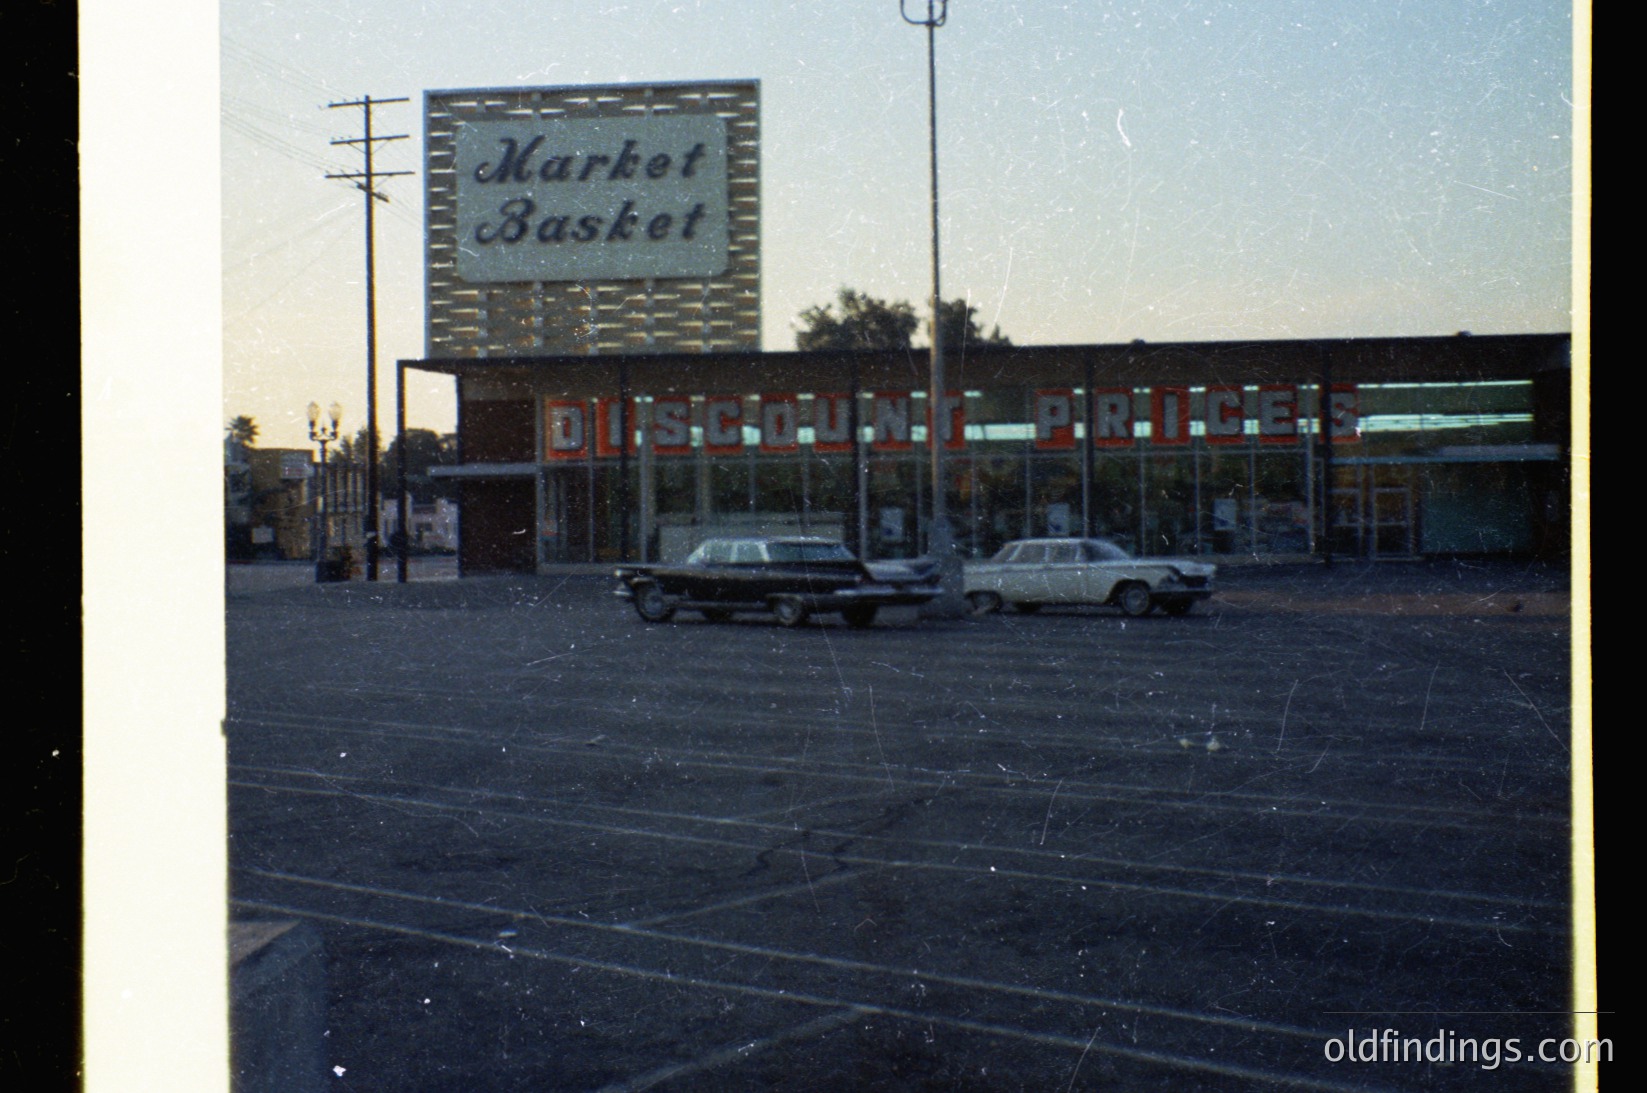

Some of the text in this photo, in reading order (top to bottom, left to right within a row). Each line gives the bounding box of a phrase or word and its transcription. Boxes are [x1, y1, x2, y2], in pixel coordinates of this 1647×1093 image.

[474, 134, 705, 184] Market
[474, 198, 705, 245] Basket
[551, 390, 1359, 450] DISCOUNT PRICES
